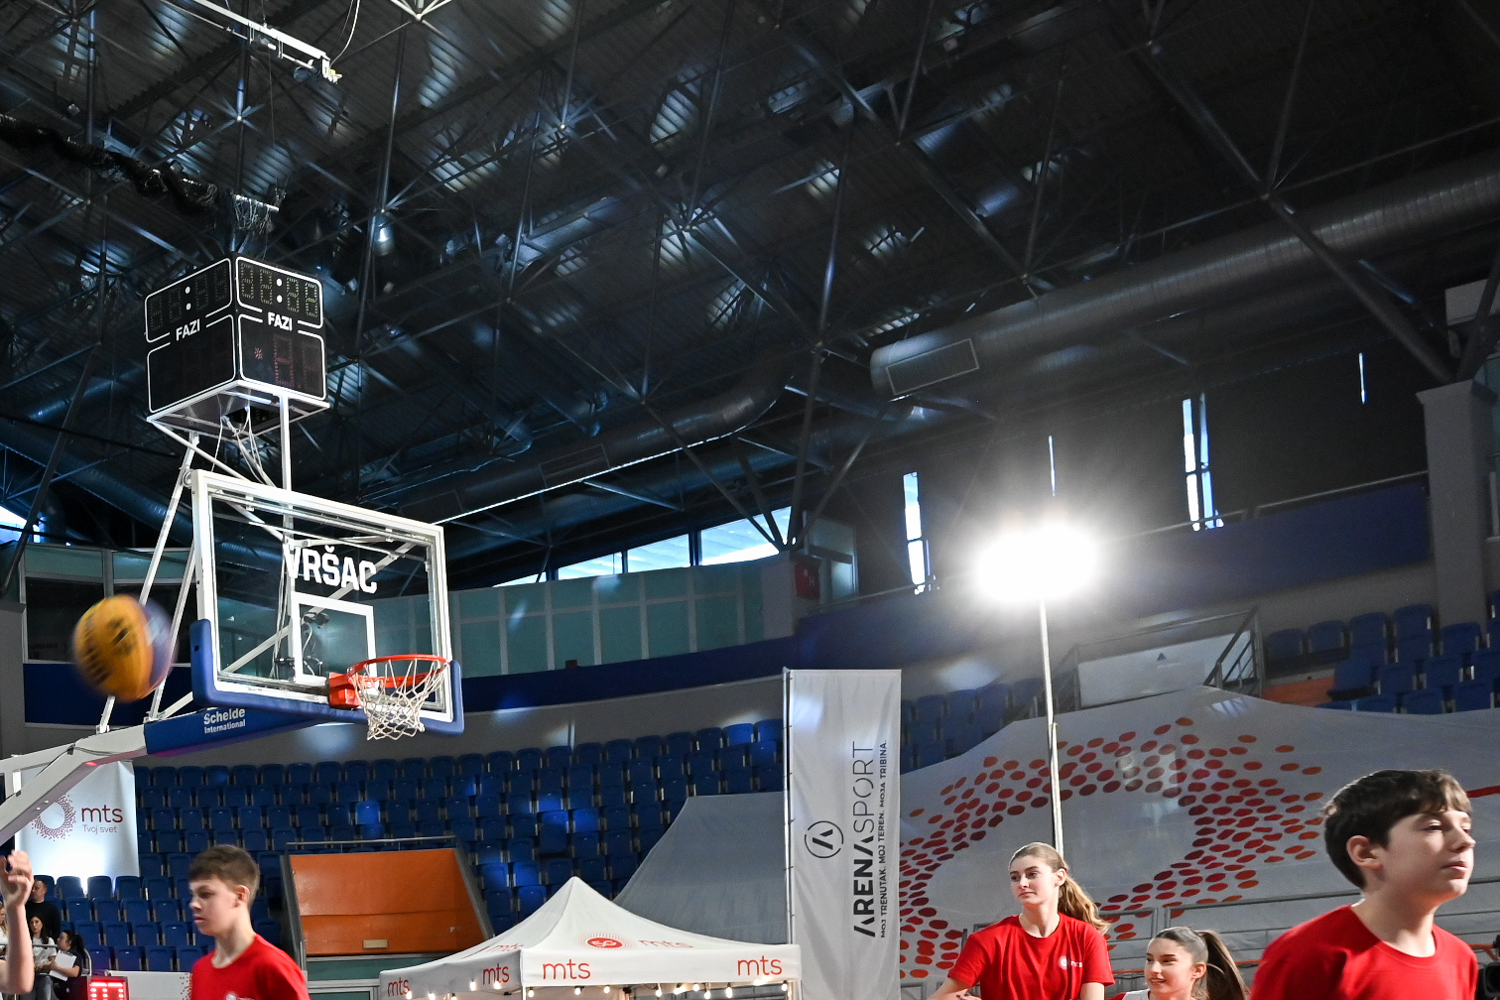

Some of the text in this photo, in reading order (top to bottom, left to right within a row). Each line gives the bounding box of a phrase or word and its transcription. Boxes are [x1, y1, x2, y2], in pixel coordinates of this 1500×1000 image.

[175, 319, 201, 342] FAZI
[267, 311, 293, 331] FAZI
[282, 544, 378, 594] VRŠAC
[203, 708, 246, 726] Schelde
[204, 719, 246, 734] International
[81, 804, 123, 823] mts
[83, 824, 117, 835] Tvoj svet
[878, 845, 886, 864] MOJ
[879, 920, 887, 938] MOJ
[482, 963, 510, 985] mts
[542, 959, 591, 980] mts
[737, 955, 784, 977] mts
[388, 976, 411, 997] mts
